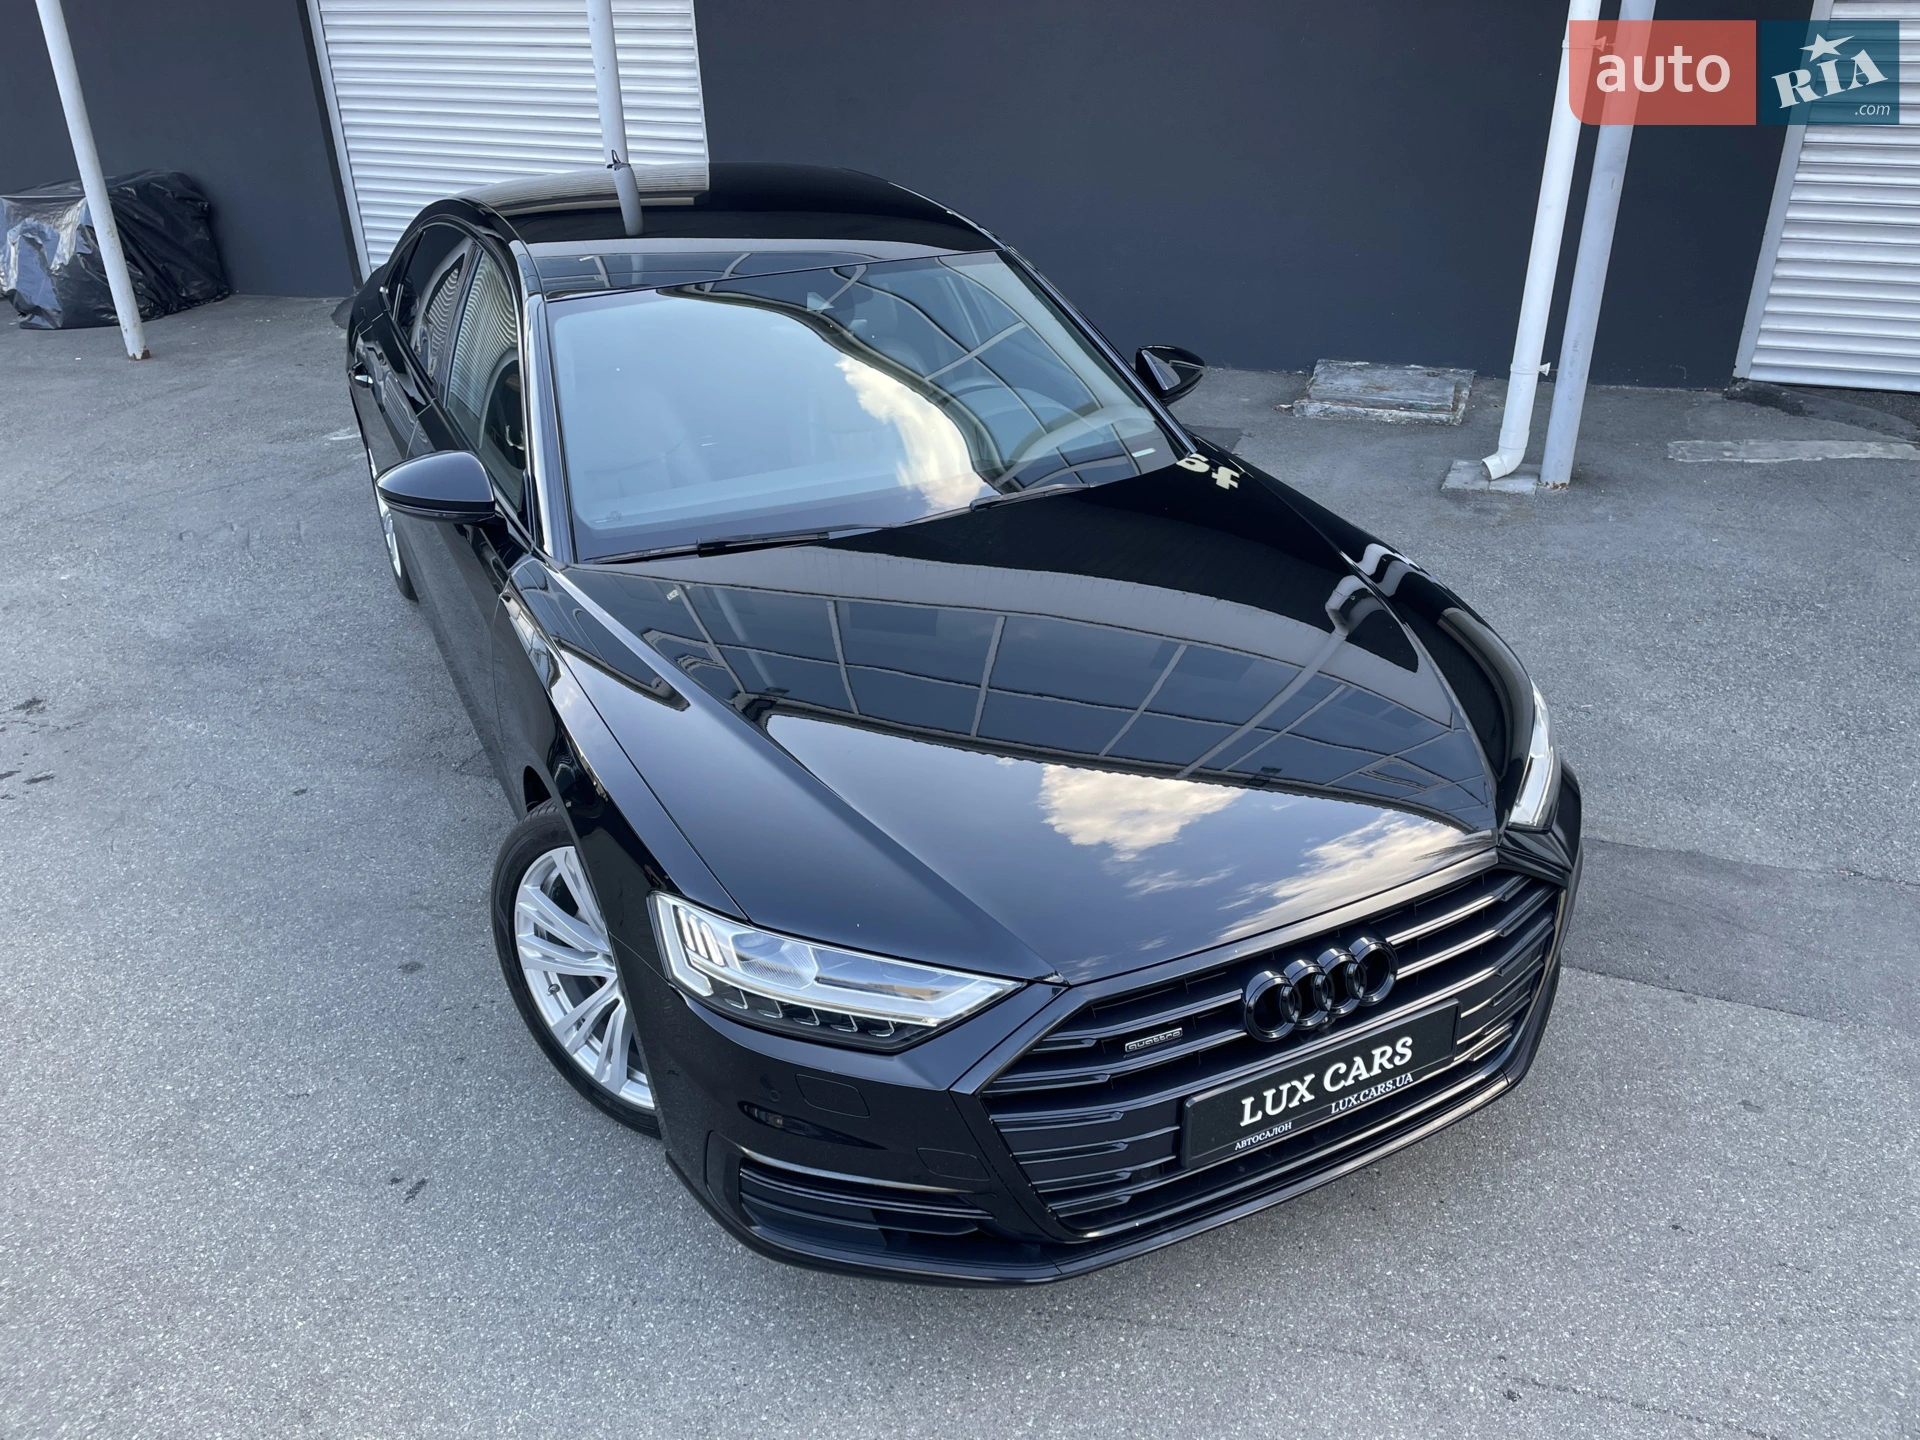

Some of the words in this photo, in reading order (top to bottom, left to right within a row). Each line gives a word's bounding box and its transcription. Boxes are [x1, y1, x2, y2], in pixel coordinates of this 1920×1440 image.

[1126, 1028, 1182, 1051] quattro
[1239, 1073, 1315, 1127] LUX
[1323, 1036, 1413, 1092] CARS
[1330, 1072, 1413, 1114] LUX.CARS.UA
[1234, 1121, 1292, 1151] АВТОСАЛОН
